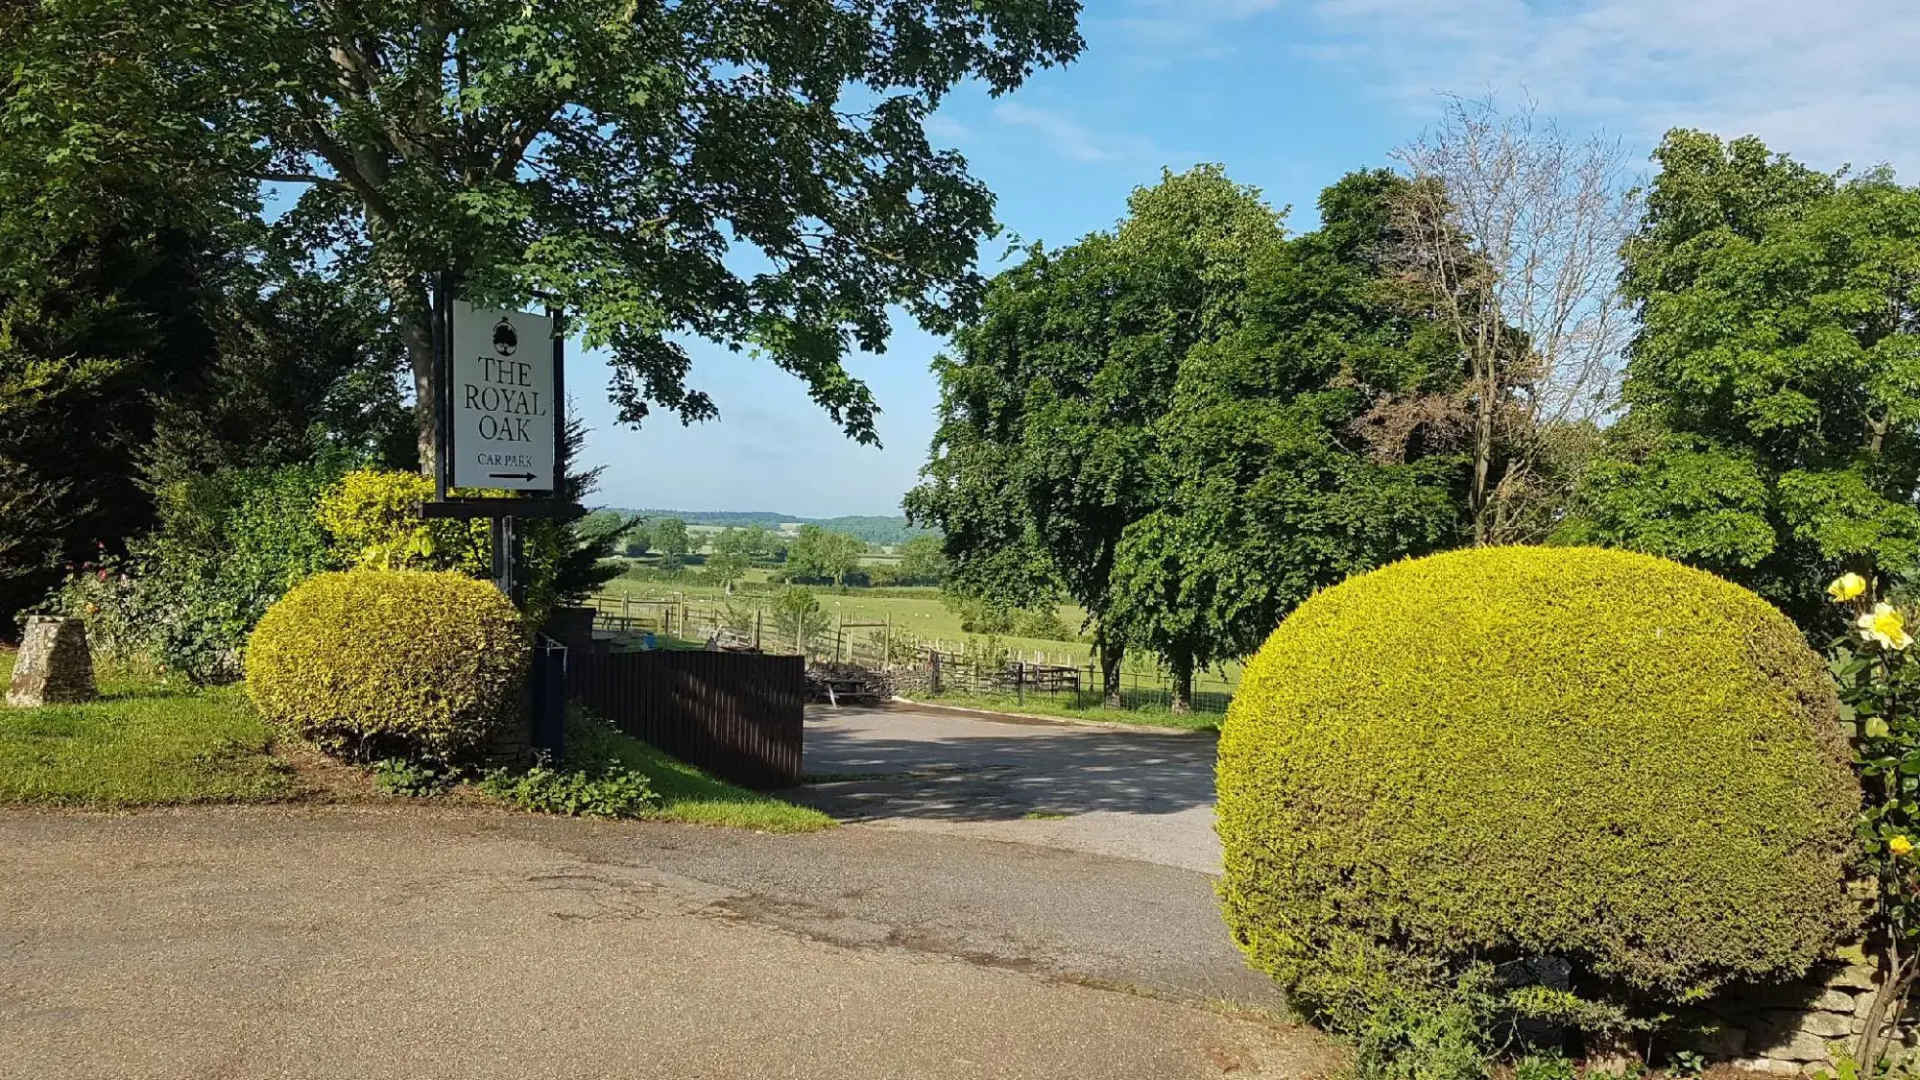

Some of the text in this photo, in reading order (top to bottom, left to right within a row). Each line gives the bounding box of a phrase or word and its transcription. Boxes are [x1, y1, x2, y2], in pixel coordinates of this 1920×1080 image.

[477, 356, 532, 387] THE
[464, 384, 546, 416] ROYAL
[478, 415, 532, 442] OAK
[477, 453, 532, 468] CAR PARK
